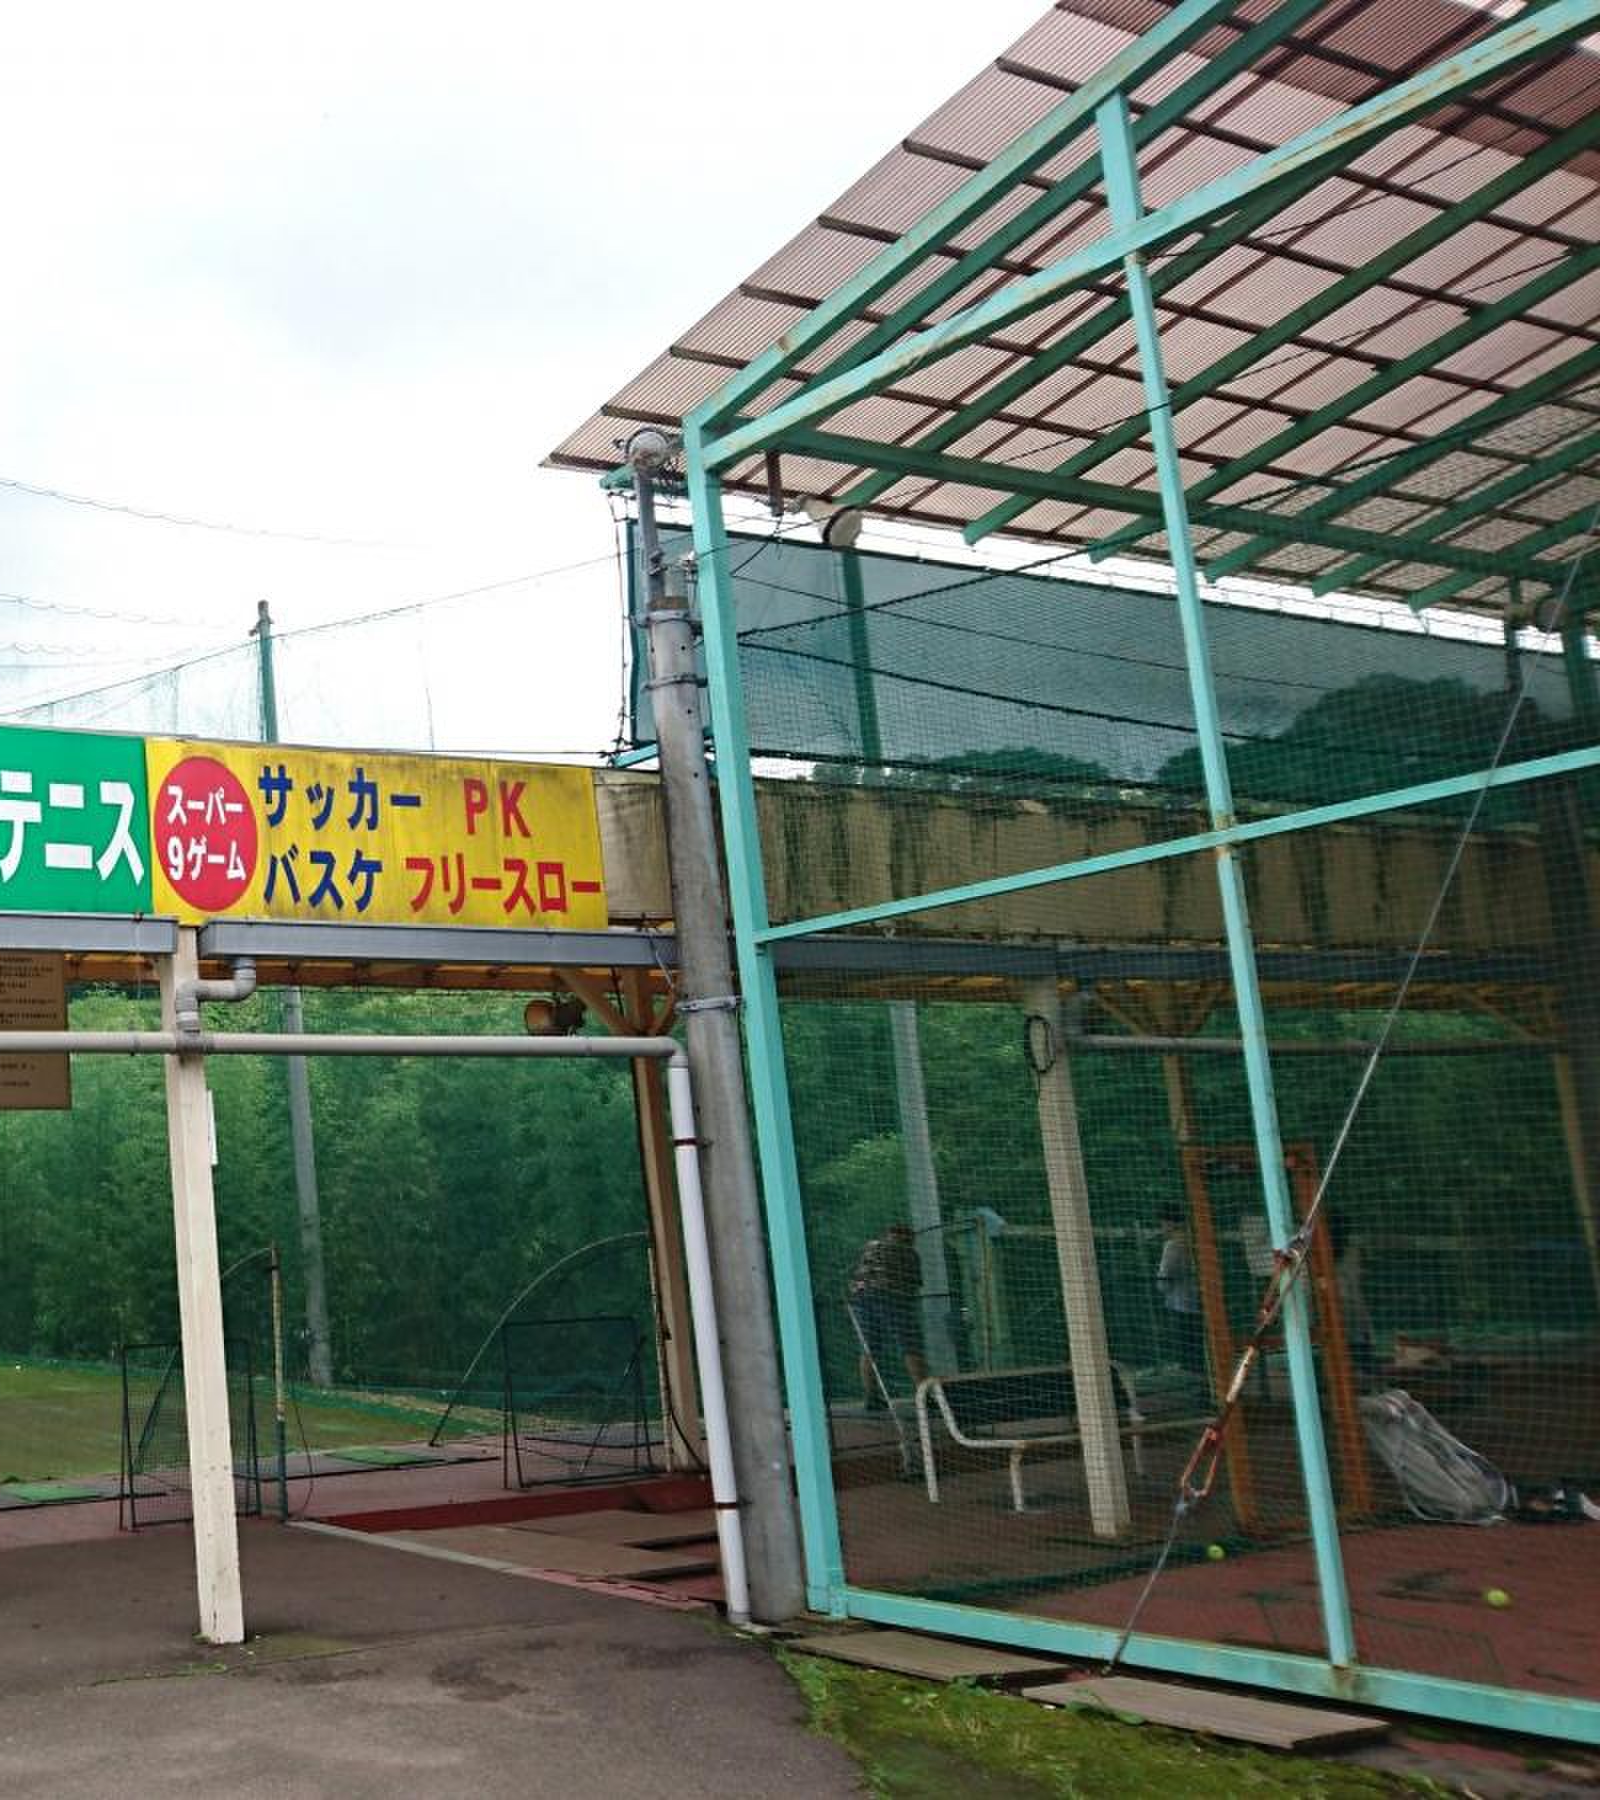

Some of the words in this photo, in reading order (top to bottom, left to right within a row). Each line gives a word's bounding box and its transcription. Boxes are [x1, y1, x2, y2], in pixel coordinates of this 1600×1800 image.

[167, 785, 244, 827] スーパー
[258, 764, 422, 832] サッカー
[463, 777, 532, 839] PK
[168, 837, 247, 881] 9ゲーム
[263, 844, 384, 913] バスケ
[405, 852, 602, 916] フリースロー
